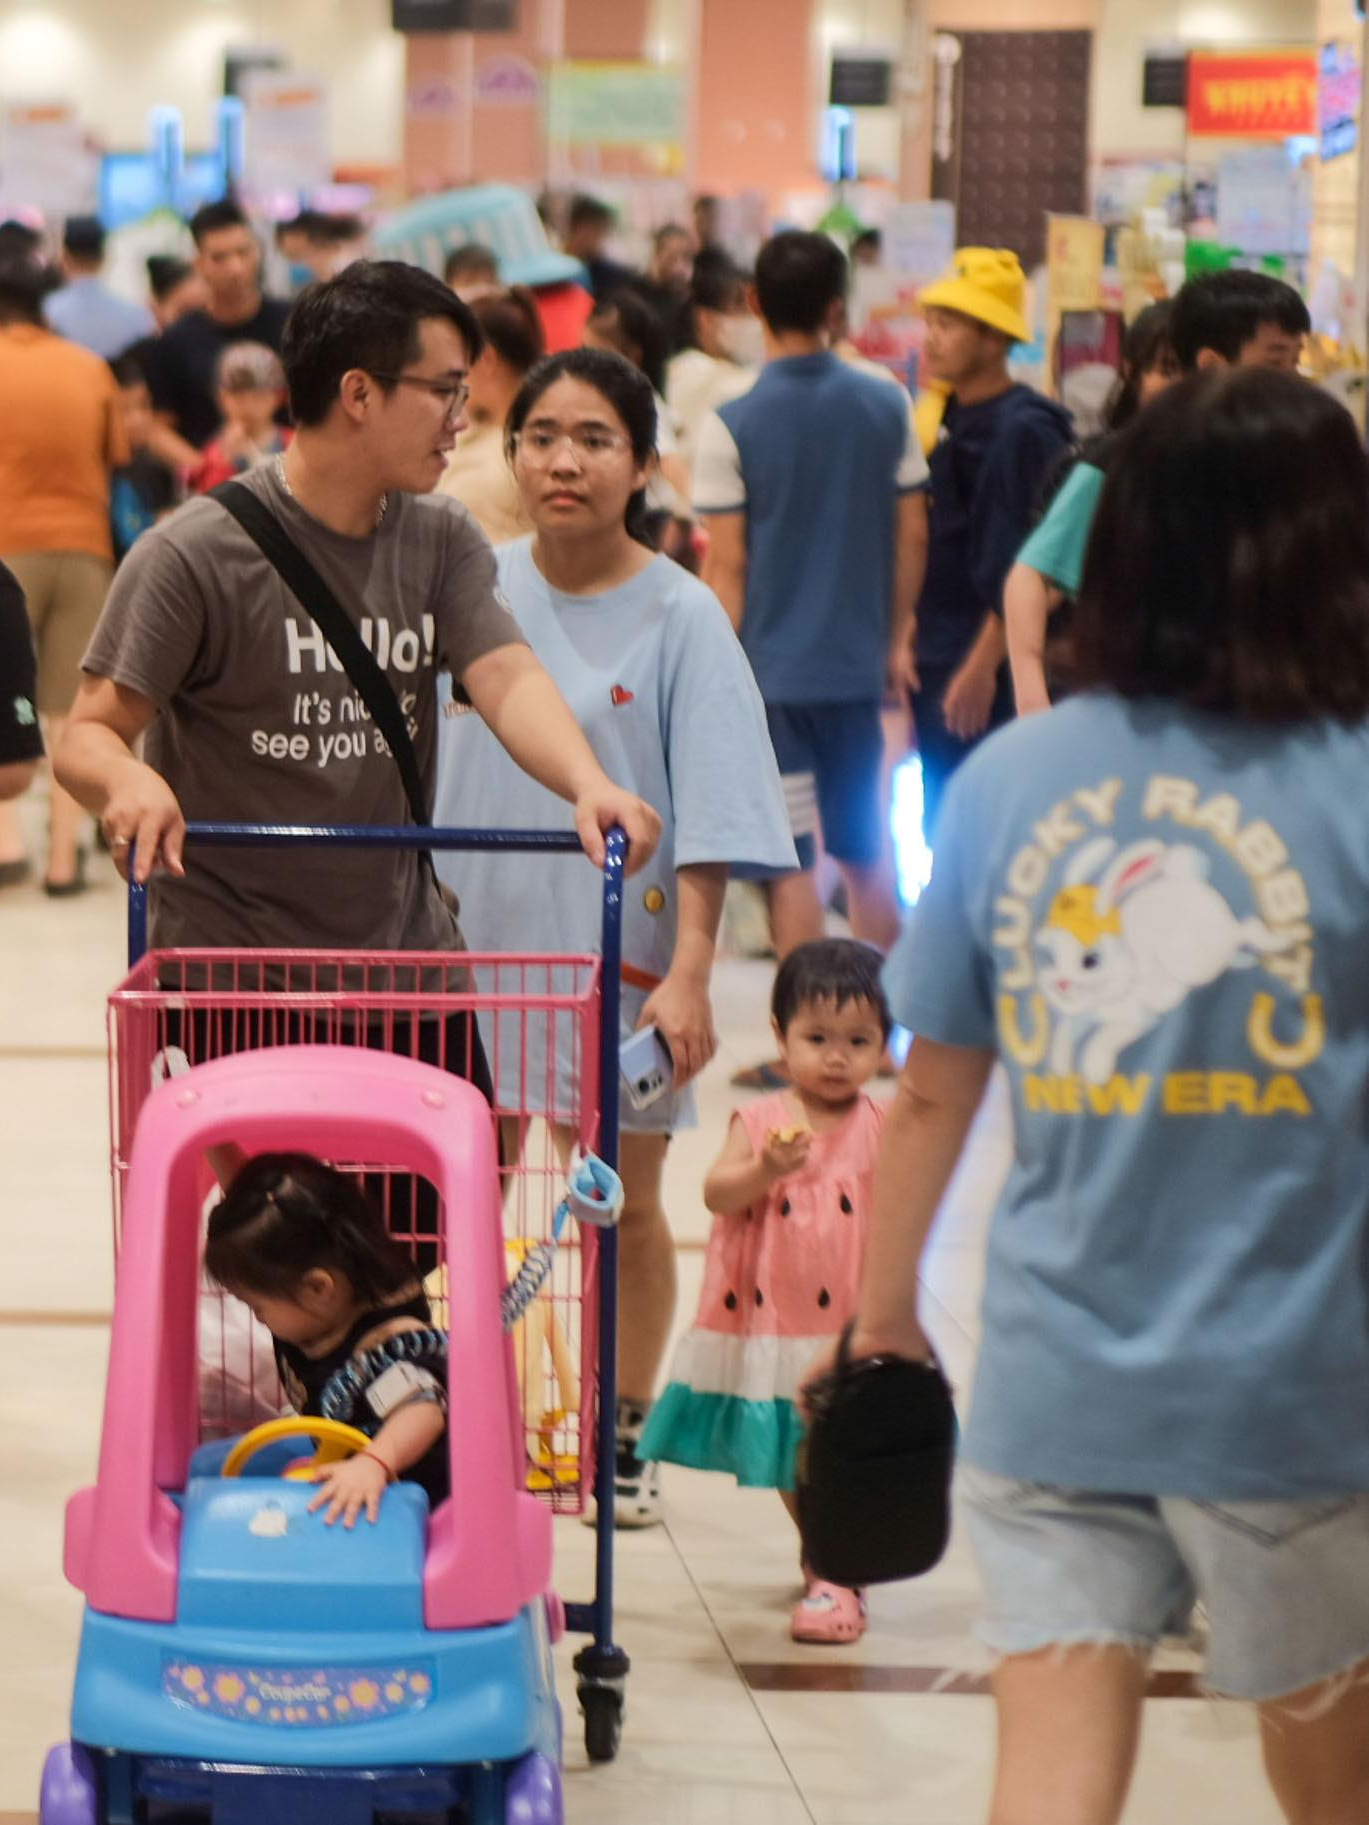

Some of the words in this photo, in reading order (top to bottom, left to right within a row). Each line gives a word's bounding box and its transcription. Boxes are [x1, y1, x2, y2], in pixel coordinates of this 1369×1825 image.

[294, 691, 331, 725] It's
[340, 689, 372, 723] nic
[251, 729, 310, 761] see
[318, 731, 366, 769] you
[993, 777, 1122, 990] LUCKY
[1162, 1071, 1312, 1116] ERA
